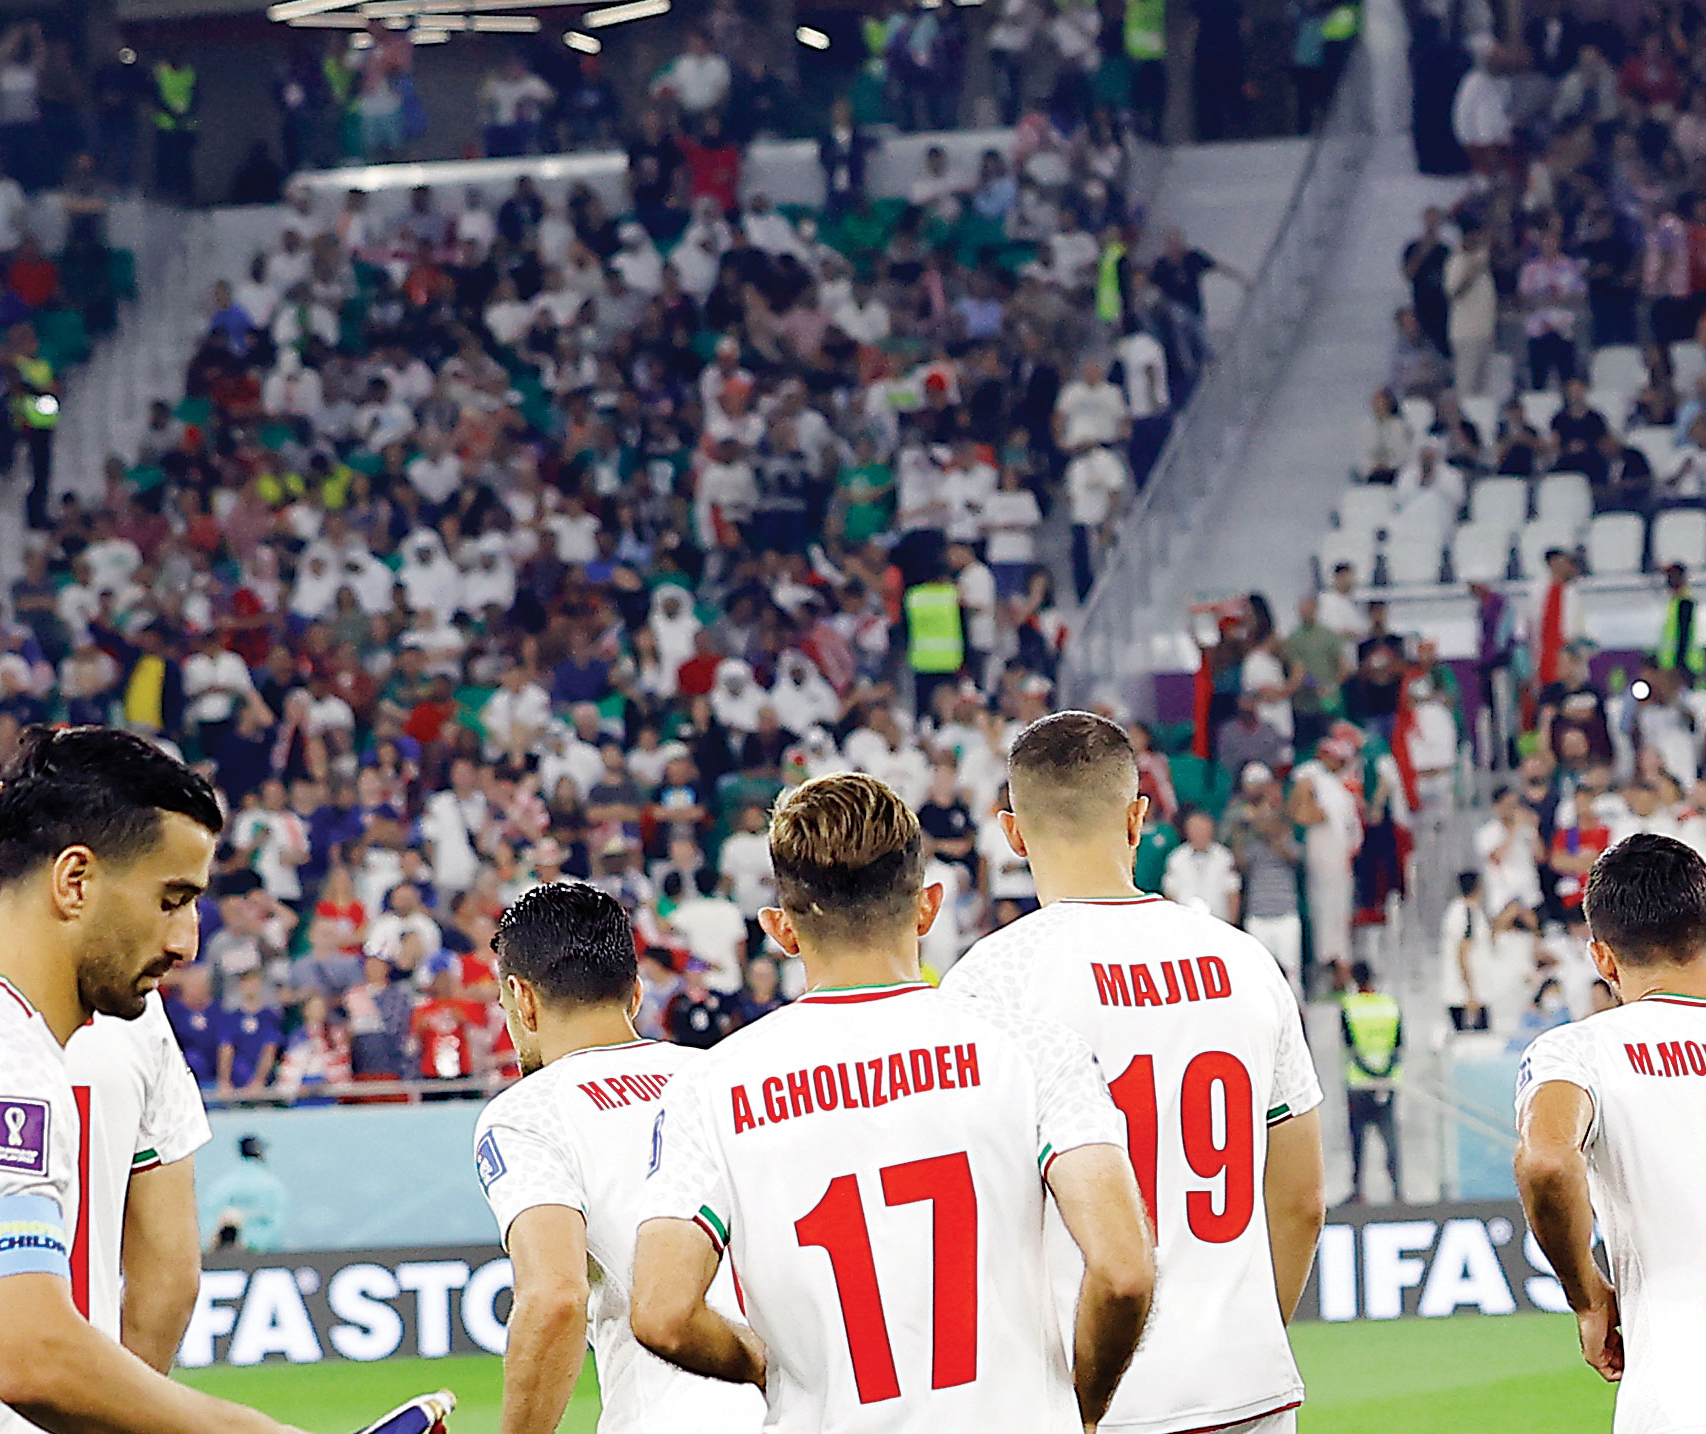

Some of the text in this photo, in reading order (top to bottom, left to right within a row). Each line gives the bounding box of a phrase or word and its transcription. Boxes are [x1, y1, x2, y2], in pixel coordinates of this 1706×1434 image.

[1090, 954, 1233, 1008] MAJID
[730, 1041, 982, 1135] A.GHOLIZADEH
[1107, 1049, 1256, 1248] 19
[176, 1257, 515, 1368] FA STO
[793, 1149, 980, 1406] 17
[1317, 1218, 1518, 1322] IFA
